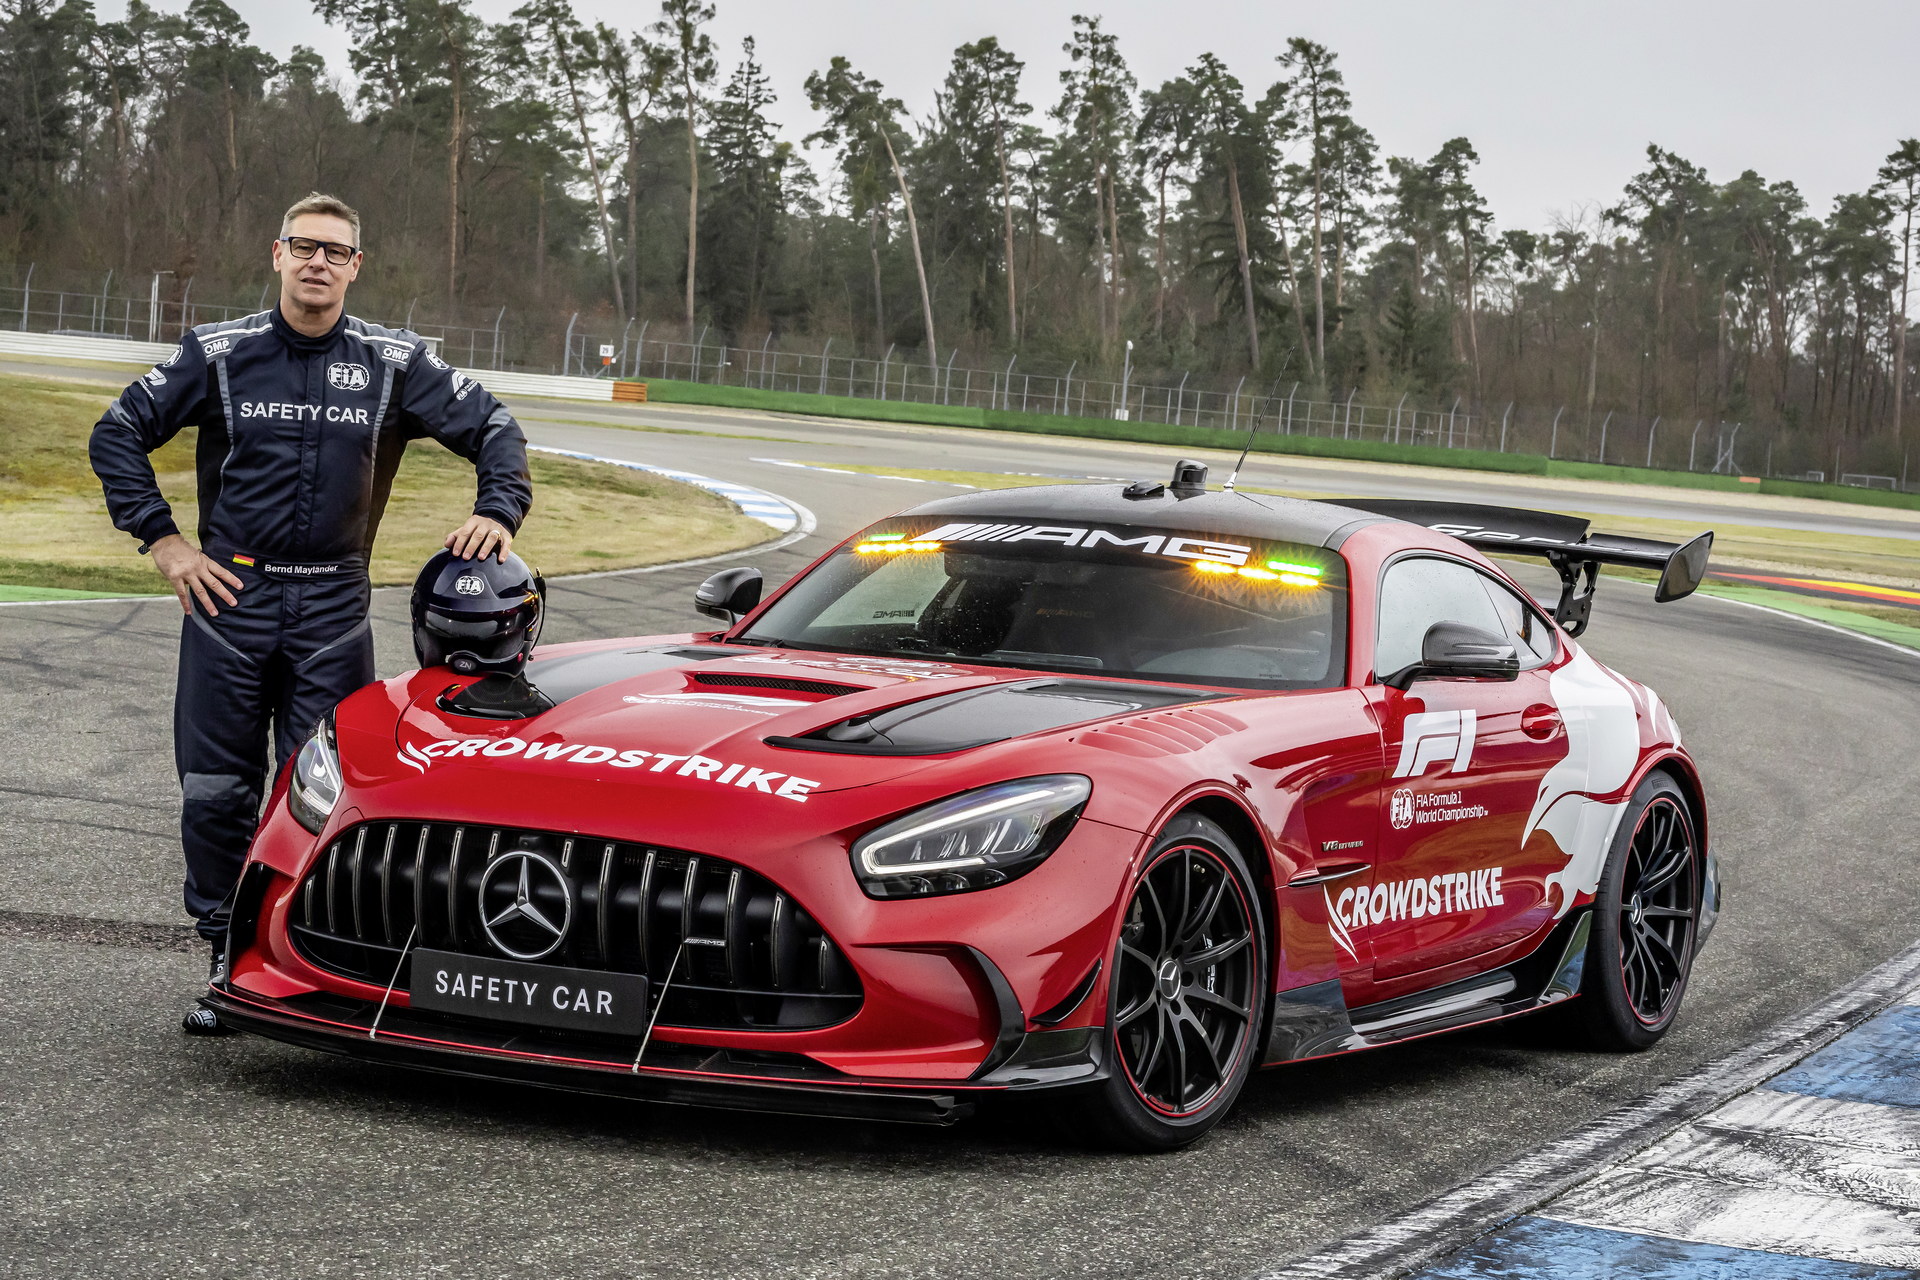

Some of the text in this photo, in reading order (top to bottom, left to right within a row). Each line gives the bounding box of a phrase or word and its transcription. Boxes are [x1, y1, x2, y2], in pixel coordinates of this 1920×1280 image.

[204, 339, 230, 355] OMP
[383, 347, 410, 361] OMP
[240, 402, 369, 425] SAFETY CAR
[1002, 526, 1252, 566] AMG
[264, 564, 293, 574] Bernd
[1392, 709, 1477, 778] F1
[420, 736, 822, 803] CROWDSTRIKE
[1416, 791, 1463, 807] FIA Formula 1
[1416, 804, 1485, 824] World Championship
[1336, 867, 1505, 928] CROWDSTRIKE
[435, 970, 613, 1015] SAFETY CAR
